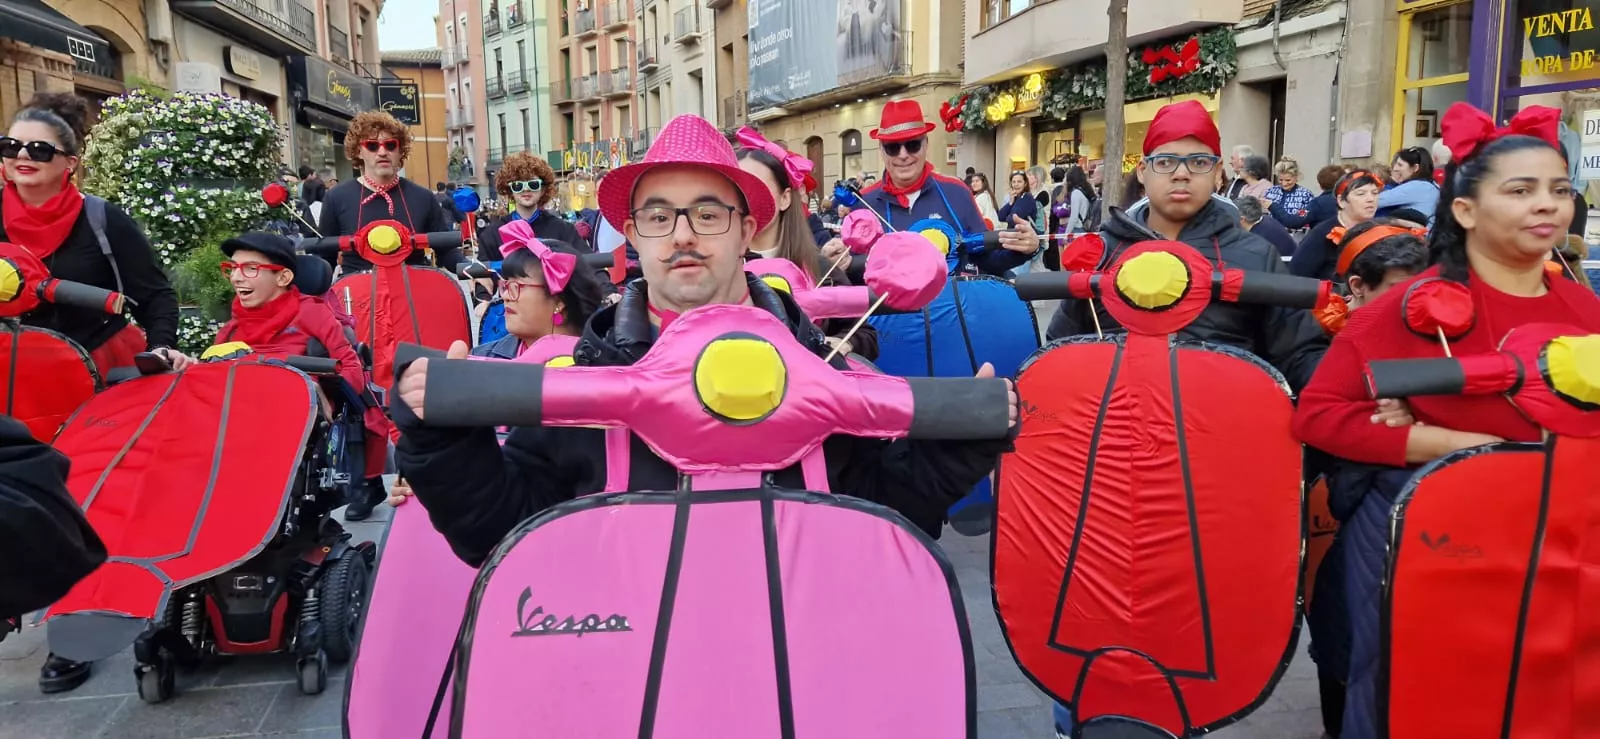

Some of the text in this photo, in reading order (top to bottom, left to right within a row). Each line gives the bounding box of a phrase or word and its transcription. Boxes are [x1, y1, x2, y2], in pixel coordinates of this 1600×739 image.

[1523, 7, 1595, 38] VENTA
[1520, 49, 1595, 77] ROPA DE
[510, 585, 634, 638] Vespa
